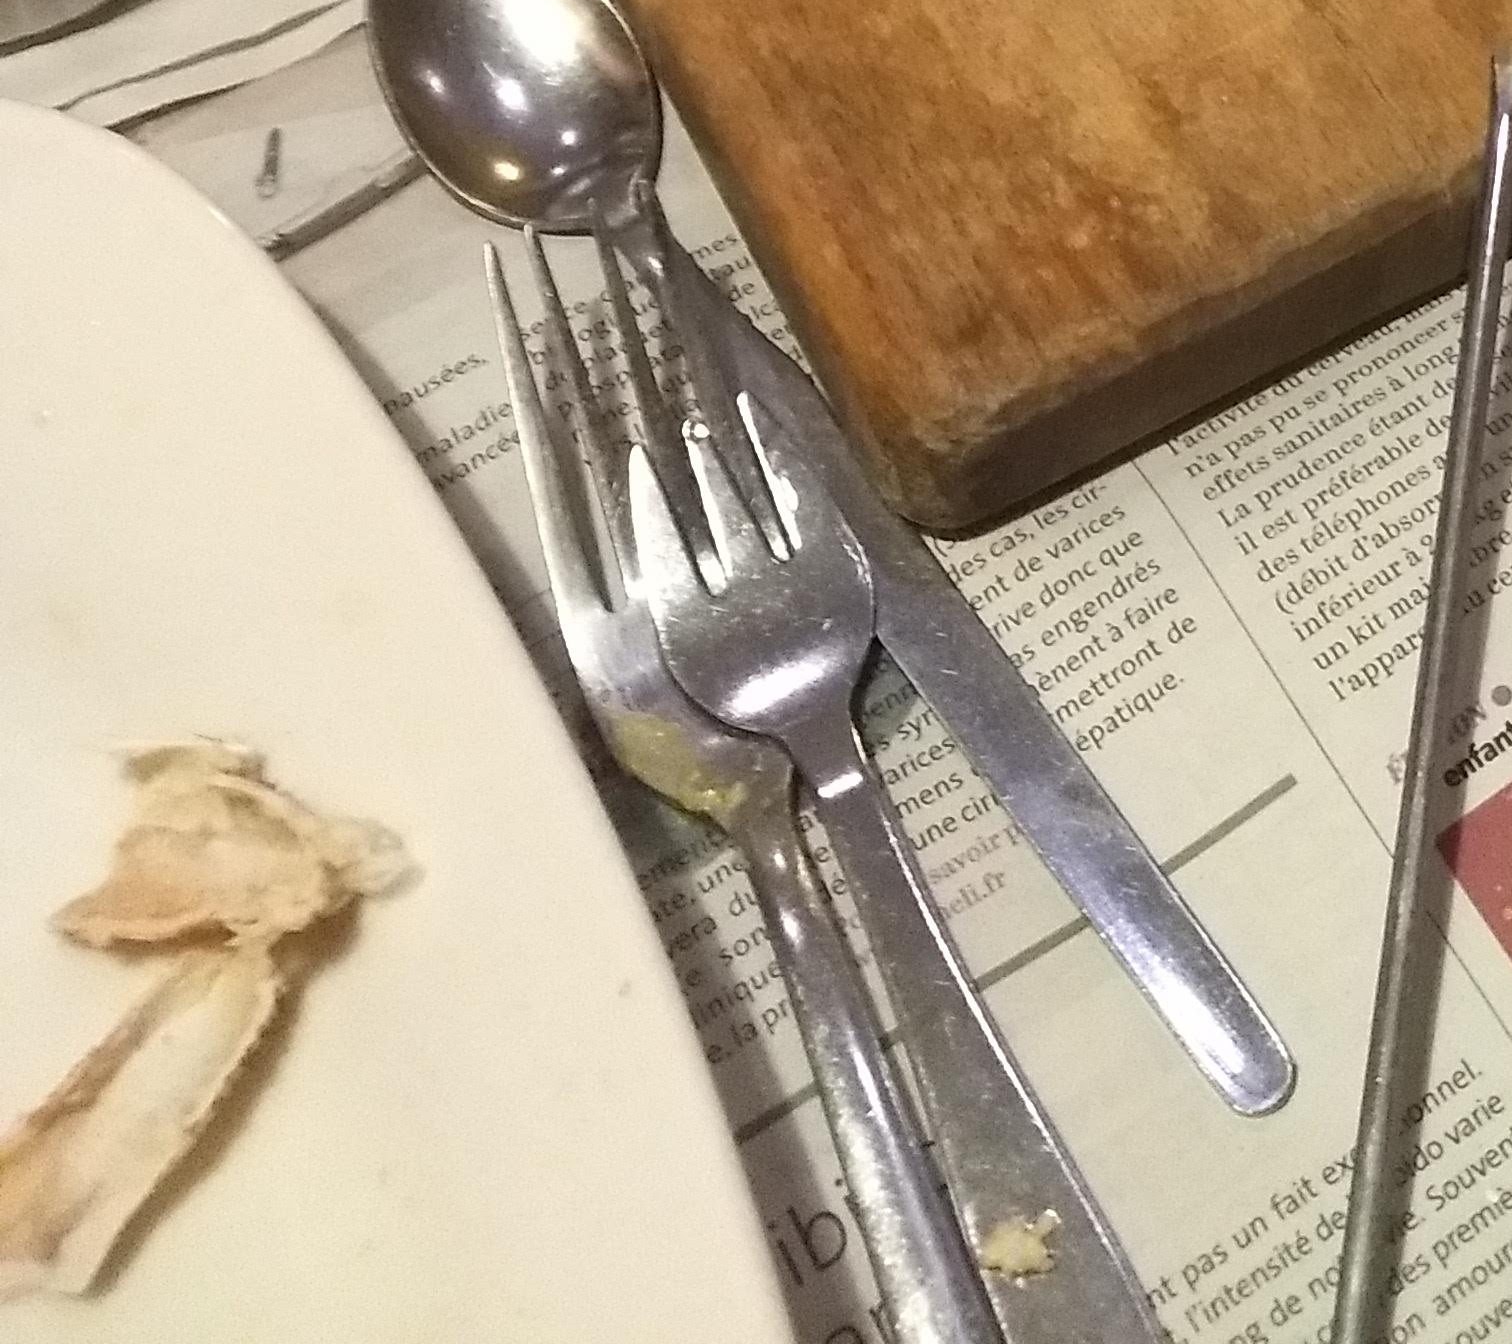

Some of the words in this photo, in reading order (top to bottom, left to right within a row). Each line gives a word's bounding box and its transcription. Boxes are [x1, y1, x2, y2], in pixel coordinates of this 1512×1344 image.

[1184, 449, 1223, 478] n'a
[1225, 426, 1266, 467] pas
[1269, 406, 1302, 437] pu
[1304, 388, 1330, 409] se
[1332, 323, 1447, 396] prononcer
[1202, 456, 1270, 502] effets
[1272, 387, 1387, 460] sanitaires
[1389, 375, 1405, 392] à
[1217, 502, 1253, 528] La
[1254, 432, 1366, 509] prudence
[1369, 394, 1429, 437] étant
[1234, 534, 1258, 556] il
[1261, 508, 1299, 540] est
[1301, 435, 1424, 520] préférable
[990, 526, 1035, 559] cas,
[1033, 505, 1068, 530] les
[1013, 553, 1044, 583] de
[1046, 502, 1126, 562] varices
[1256, 548, 1300, 584] des
[1302, 462, 1431, 553] téléphones
[1039, 563, 1098, 608] donc
[1100, 529, 1144, 575] que
[1041, 557, 1161, 645] engendrés
[1275, 556, 1349, 614] (débit
[1291, 563, 1402, 642] inférieur
[1109, 623, 1124, 643] à
[1126, 585, 1180, 631] faire
[1167, 614, 1198, 644] de
[1312, 639, 1349, 667] un
[1350, 610, 1388, 645] kit
[1444, 1094, 1506, 1145] varie
[1181, 1243, 1228, 1291] pas
[1270, 1176, 1318, 1220] fait
